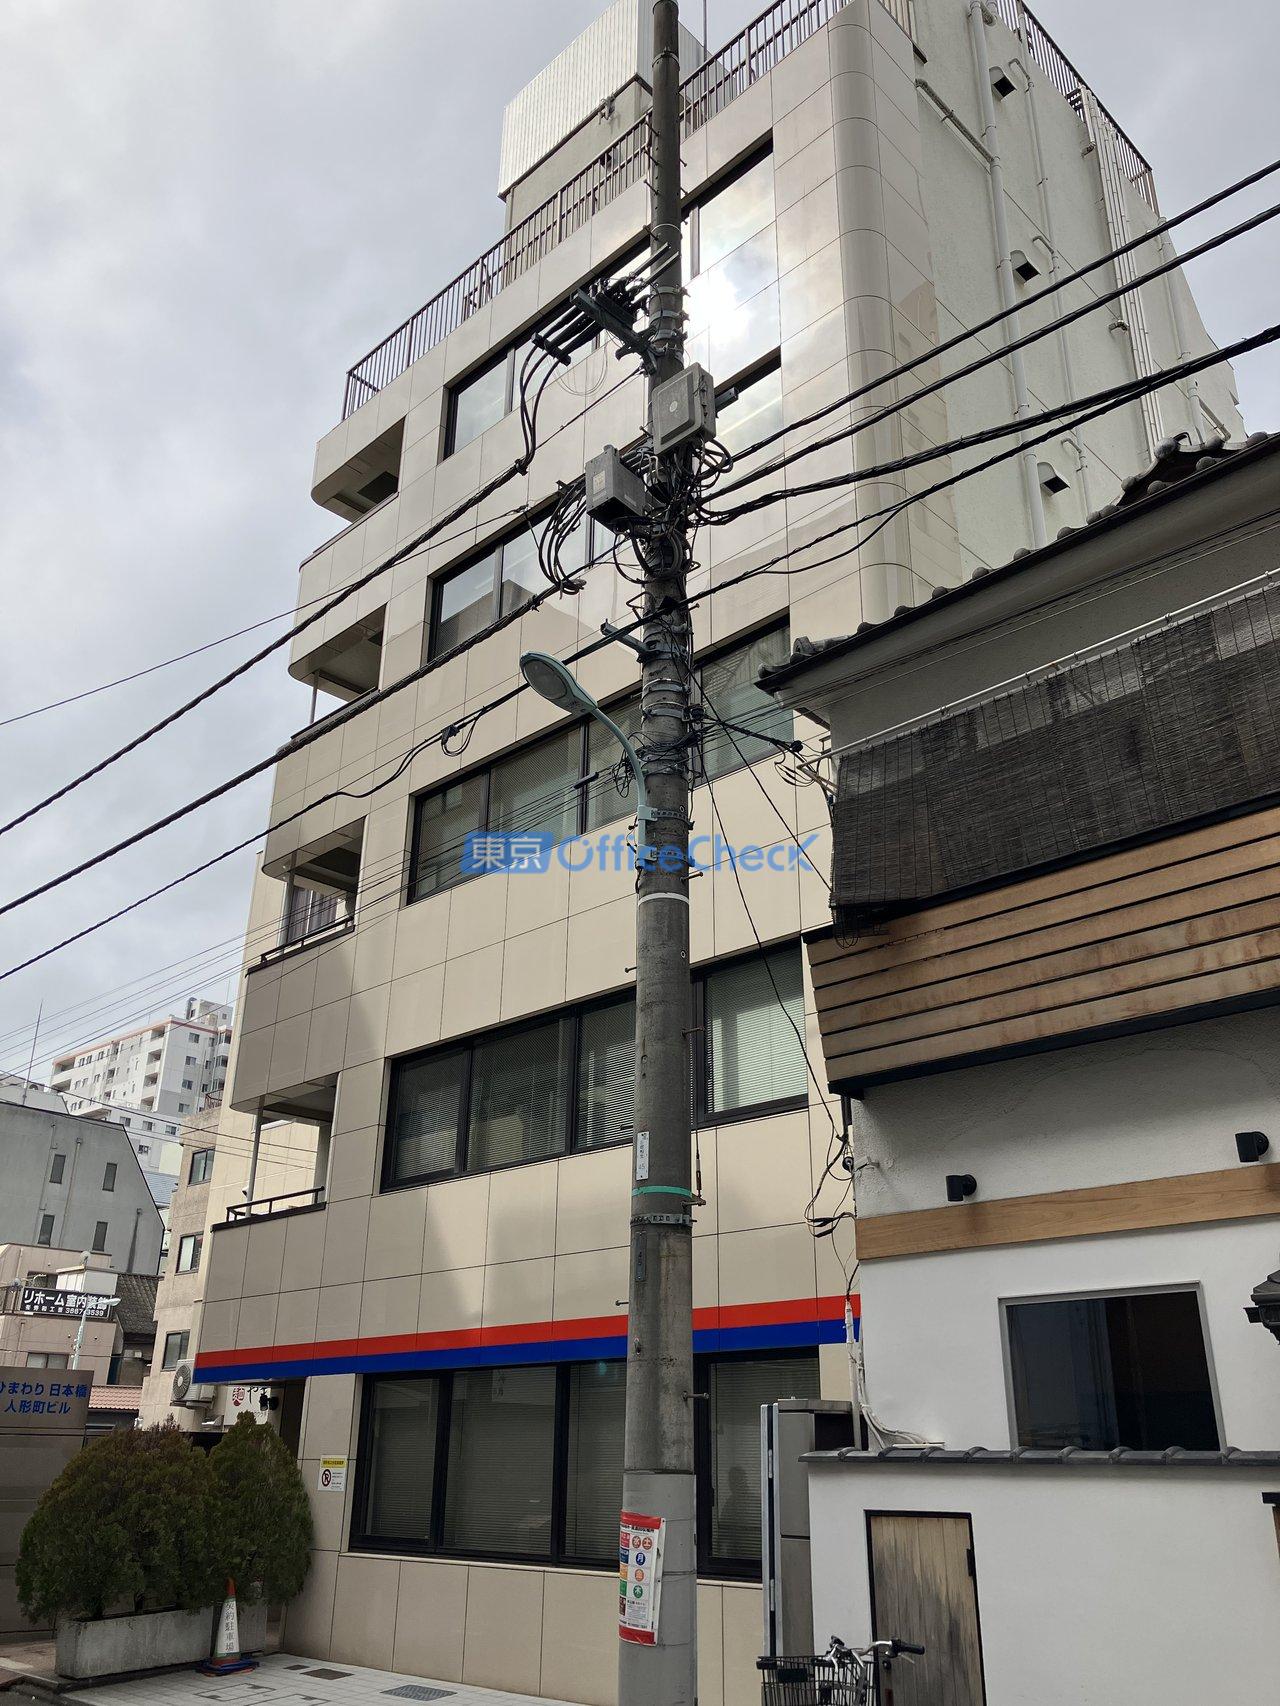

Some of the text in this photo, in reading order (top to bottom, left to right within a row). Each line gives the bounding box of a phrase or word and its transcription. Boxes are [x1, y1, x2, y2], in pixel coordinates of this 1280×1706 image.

[4, 1398, 71, 1414] 人形町ビル
